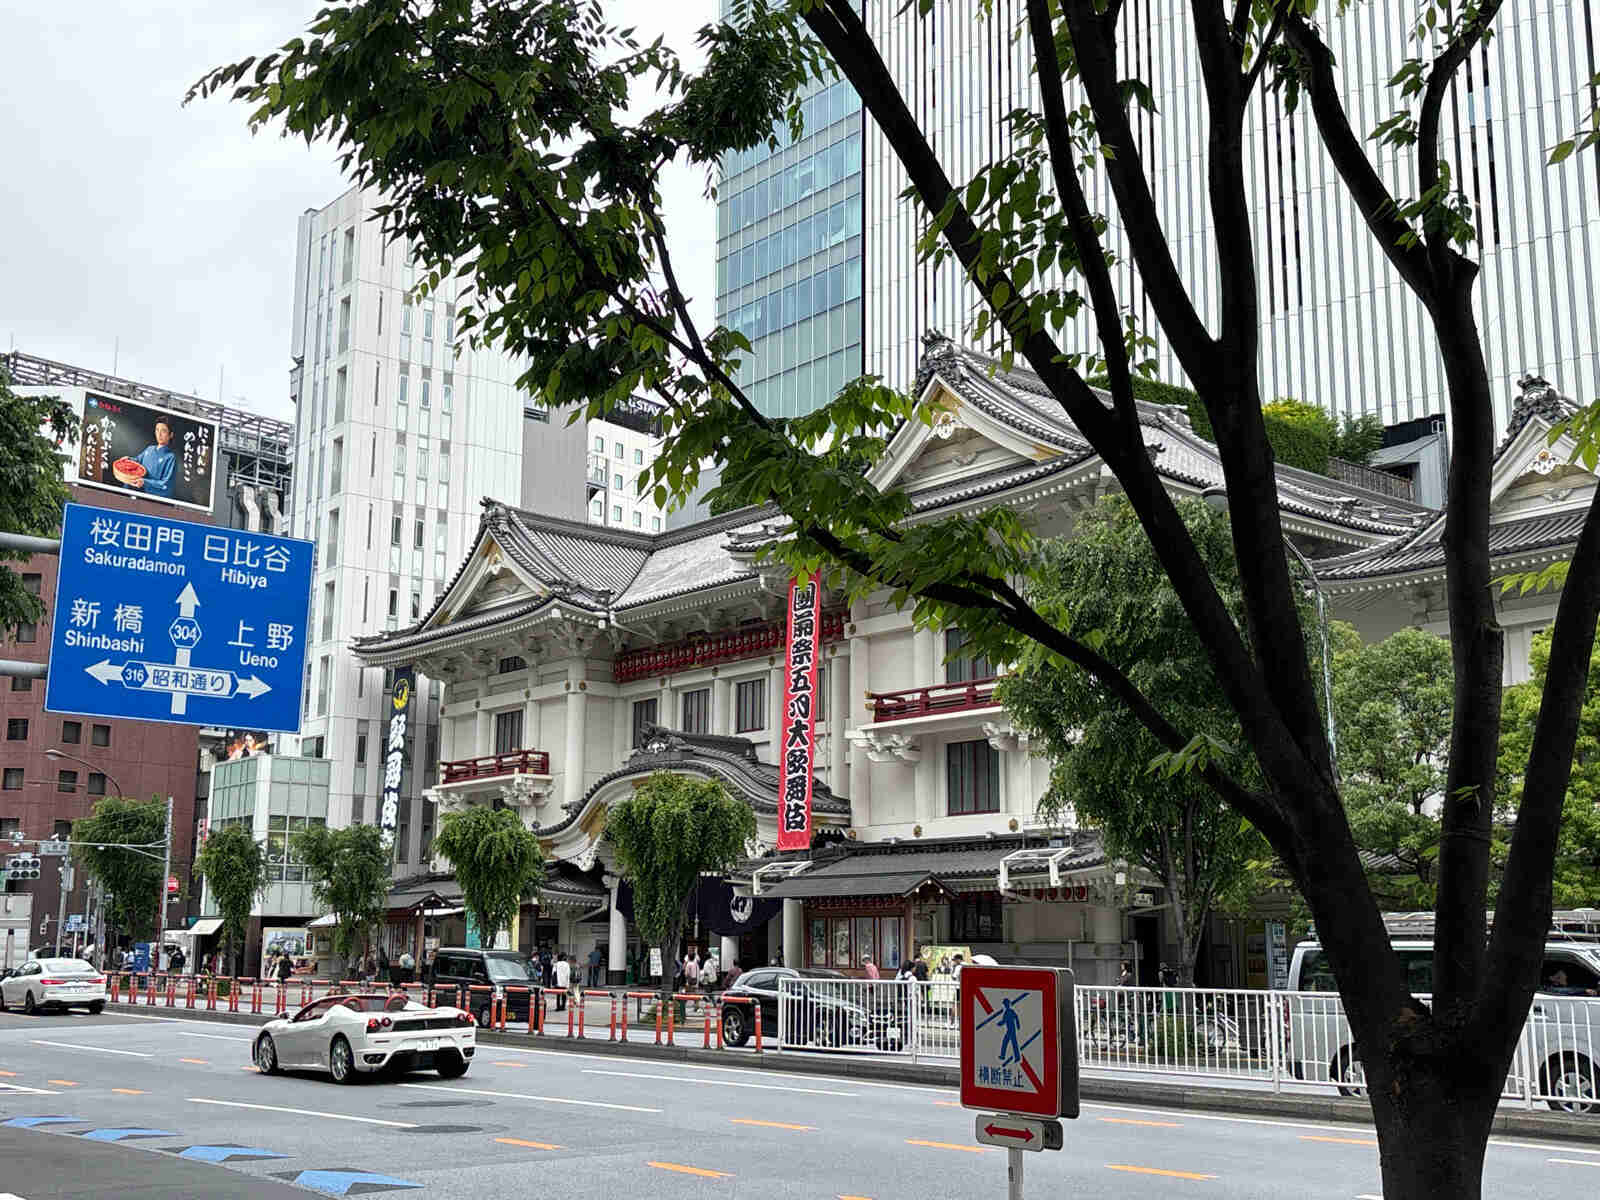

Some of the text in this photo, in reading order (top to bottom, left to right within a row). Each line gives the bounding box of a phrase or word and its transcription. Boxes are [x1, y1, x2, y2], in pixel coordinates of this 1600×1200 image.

[90, 516, 185, 557] 桜田門
[84, 547, 186, 577] Sakuradamon
[203, 534, 291, 573] 日比谷
[220, 568, 268, 589] Hibiya
[70, 598, 145, 634] 新橋
[64, 630, 145, 654] Shinbashi
[173, 625, 197, 641] 304
[227, 619, 294, 652] 上野
[239, 650, 279, 669] Ueno
[124, 667, 145, 683] 316
[152, 668, 226, 692] 昭和通り
[978, 1065, 1025, 1088] 横断禁止
